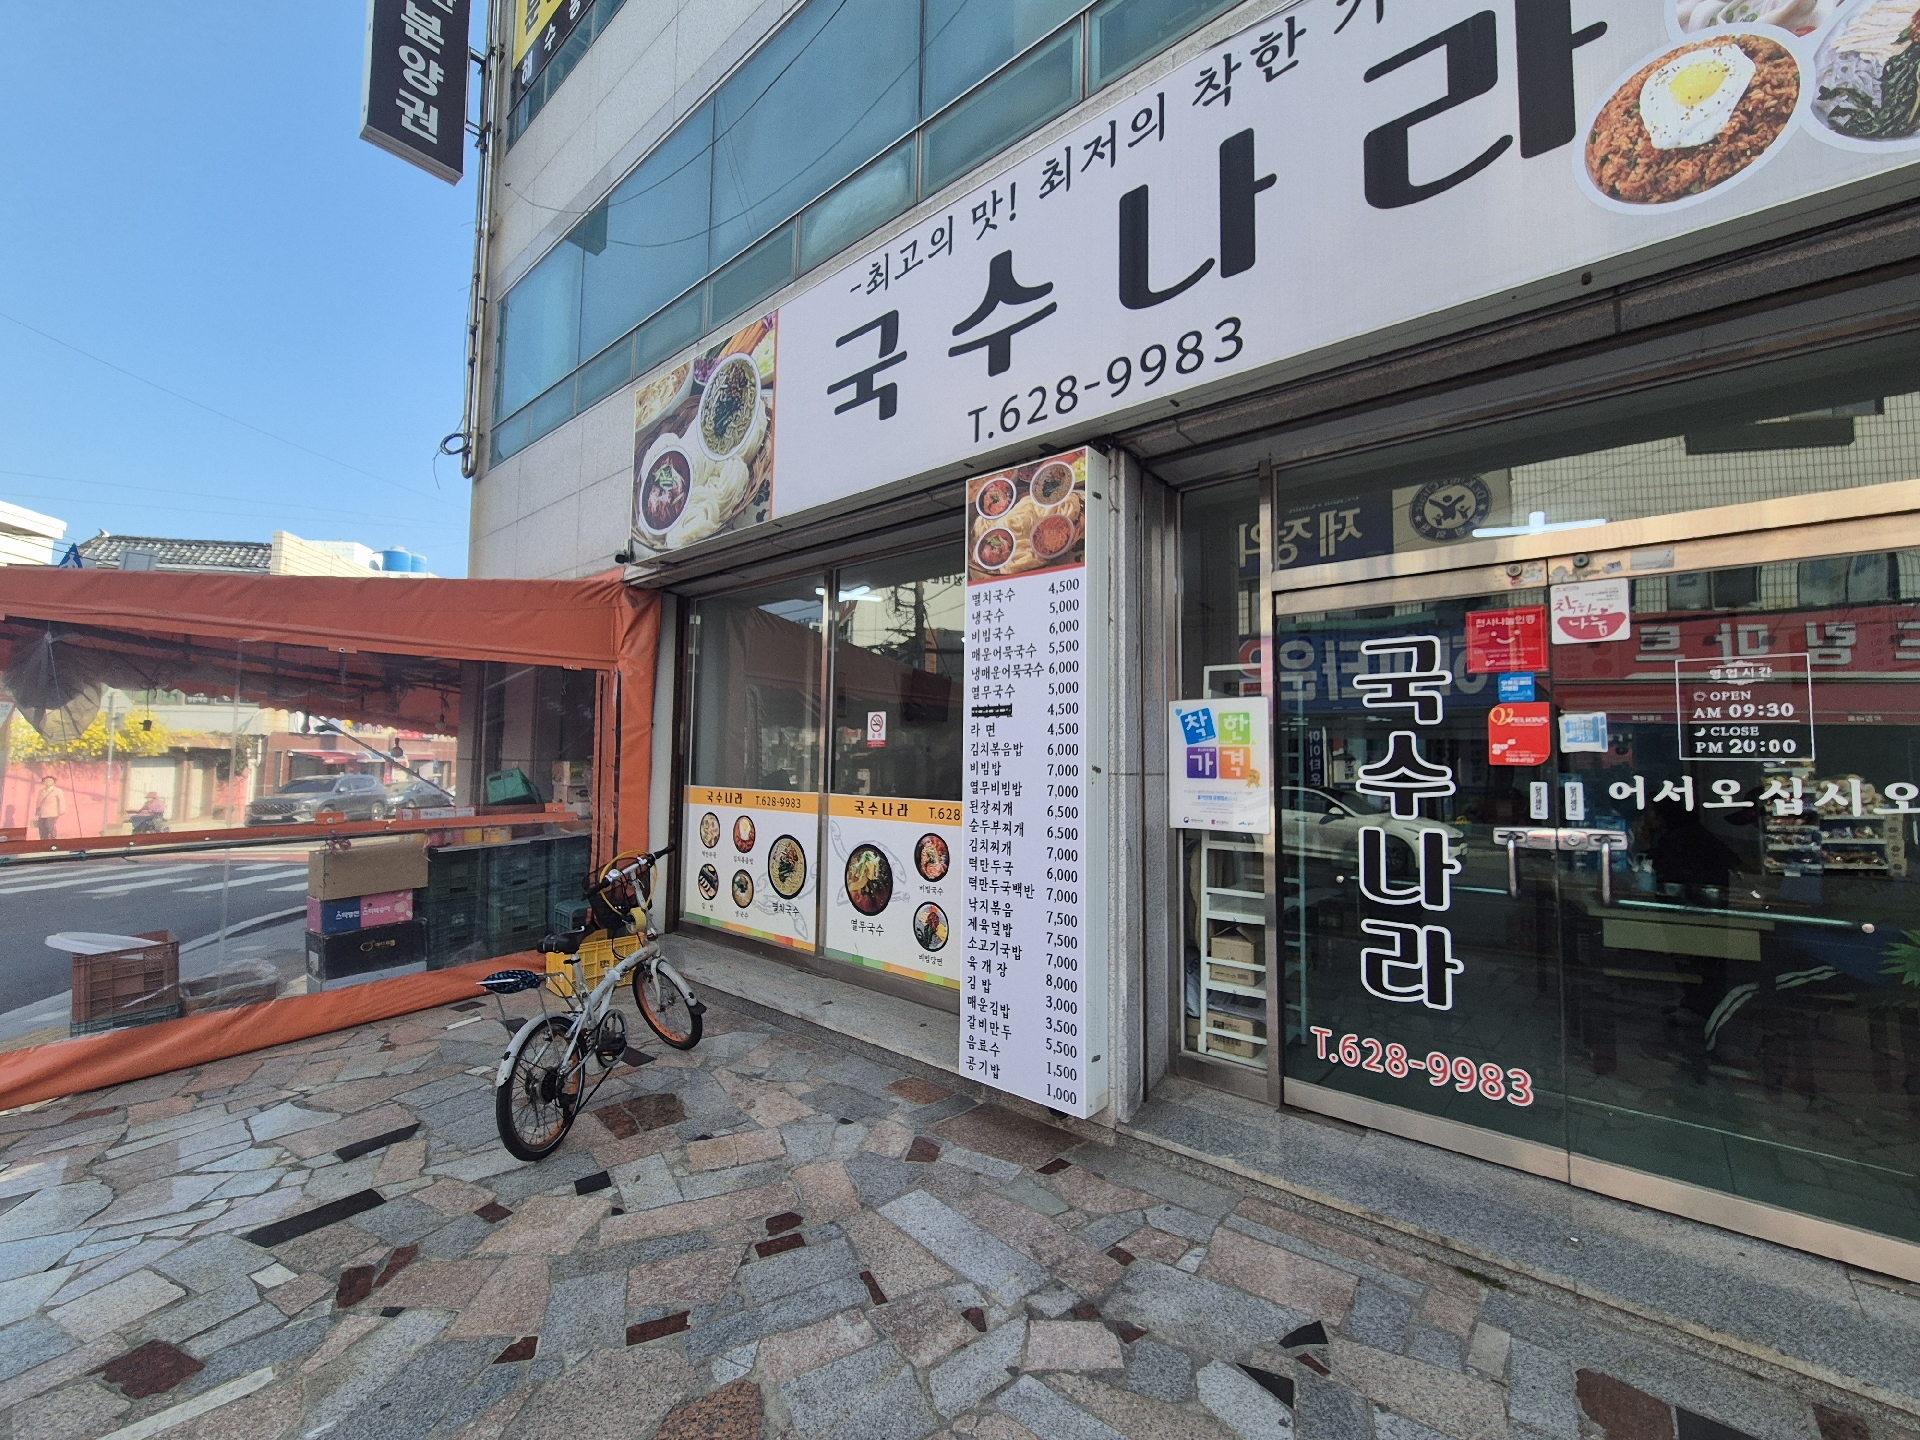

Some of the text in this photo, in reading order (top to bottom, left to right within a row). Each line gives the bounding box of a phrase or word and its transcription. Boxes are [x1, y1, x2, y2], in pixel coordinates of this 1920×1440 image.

[395, 0, 454, 144] 분양권
[972, 182, 1017, 240] 맛!
[1040, 92, 1167, 200] 최저의
[1193, 17, 1307, 109] 착한
[826, 0, 1607, 421] 국수나라
[968, 316, 1245, 443] T.628-9983
[971, 578, 1079, 606] 멸치국수 4,500
[971, 598, 1079, 625] 냉국수 5,000
[971, 619, 1079, 643] 비빔국수 6,000
[971, 639, 1079, 661] 매운어묵국수 5,500
[971, 660, 1078, 681] 냉매운어묵국수 6,000
[1709, 667, 1773, 680] 영업시간
[971, 681, 1078, 699] 열무국수 5,000
[1709, 690, 1751, 701] OPEN
[1046, 701, 1078, 716] 4,500
[1692, 703, 1794, 719] AM 09:30
[1046, 722, 1078, 736] 4,500
[1710, 726, 1759, 737] CLOSE
[970, 741, 1078, 756] 김치볶음밥 6,000
[1694, 739, 1797, 754] PM 20:00
[969, 760, 1078, 777] 비빔밥 7,000
[1190, 749, 1245, 776] 가격
[707, 791, 801, 809] 국수나라 T.628-9983
[969, 779, 1078, 798] 열무비빔밥 7,000
[854, 800, 962, 821] 국수나라 T.628
[969, 798, 1078, 819] 된장찌개 6,500
[968, 817, 1078, 840] 순두부찌개 6,500
[1353, 635, 1465, 1011] 국수나라
[968, 837, 1078, 862] 김치찌개 7,000
[968, 856, 1077, 883] 떡만두국 6,000
[967, 875, 1077, 904] 떡만두국백반 7,000
[968, 896, 1077, 927] 낙지볶음 7,500
[967, 916, 1077, 949] 제육덮밥 7,500
[966, 935, 1077, 971] 소고기국밥 7,000
[1045, 973, 1077, 993] 8,000
[967, 995, 1077, 1036] 매운김밥 3,500
[1045, 995, 1077, 1014] 3,000
[966, 1014, 1077, 1058] 갈비만두 5,500
[965, 1034, 1076, 1081] 음료수 1,500
[1309, 1025, 1535, 1108] T.628-9983
[965, 1055, 1076, 1104] 공기밥 1,000
